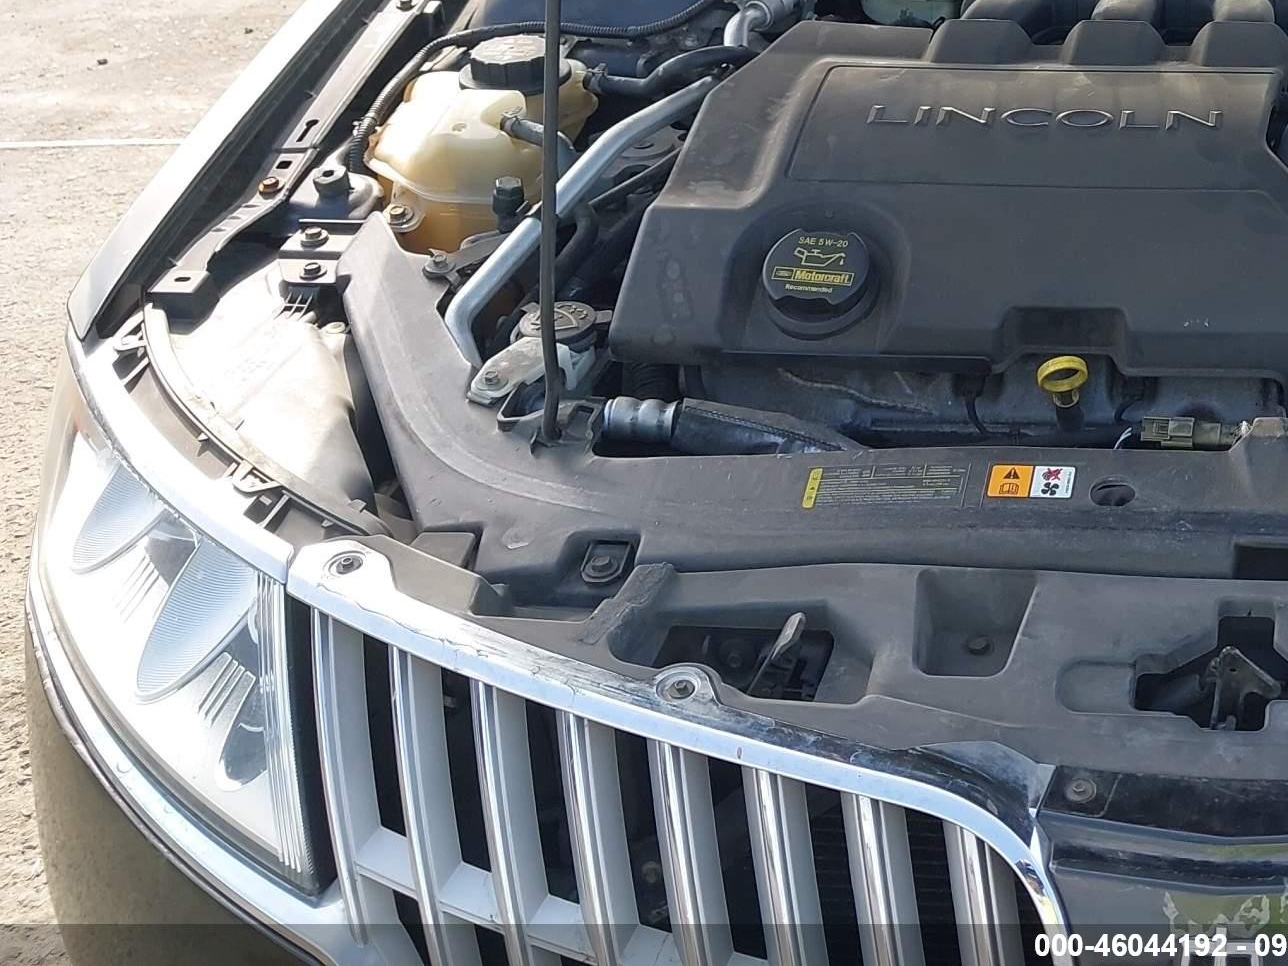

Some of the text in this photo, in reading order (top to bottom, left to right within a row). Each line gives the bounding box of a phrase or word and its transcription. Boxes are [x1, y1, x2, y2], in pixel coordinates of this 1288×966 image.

[865, 105, 1222, 130] LINCOLN
[798, 236, 816, 246] SAE
[794, 270, 850, 284] Motorcraft
[785, 283, 833, 293] Recommended
